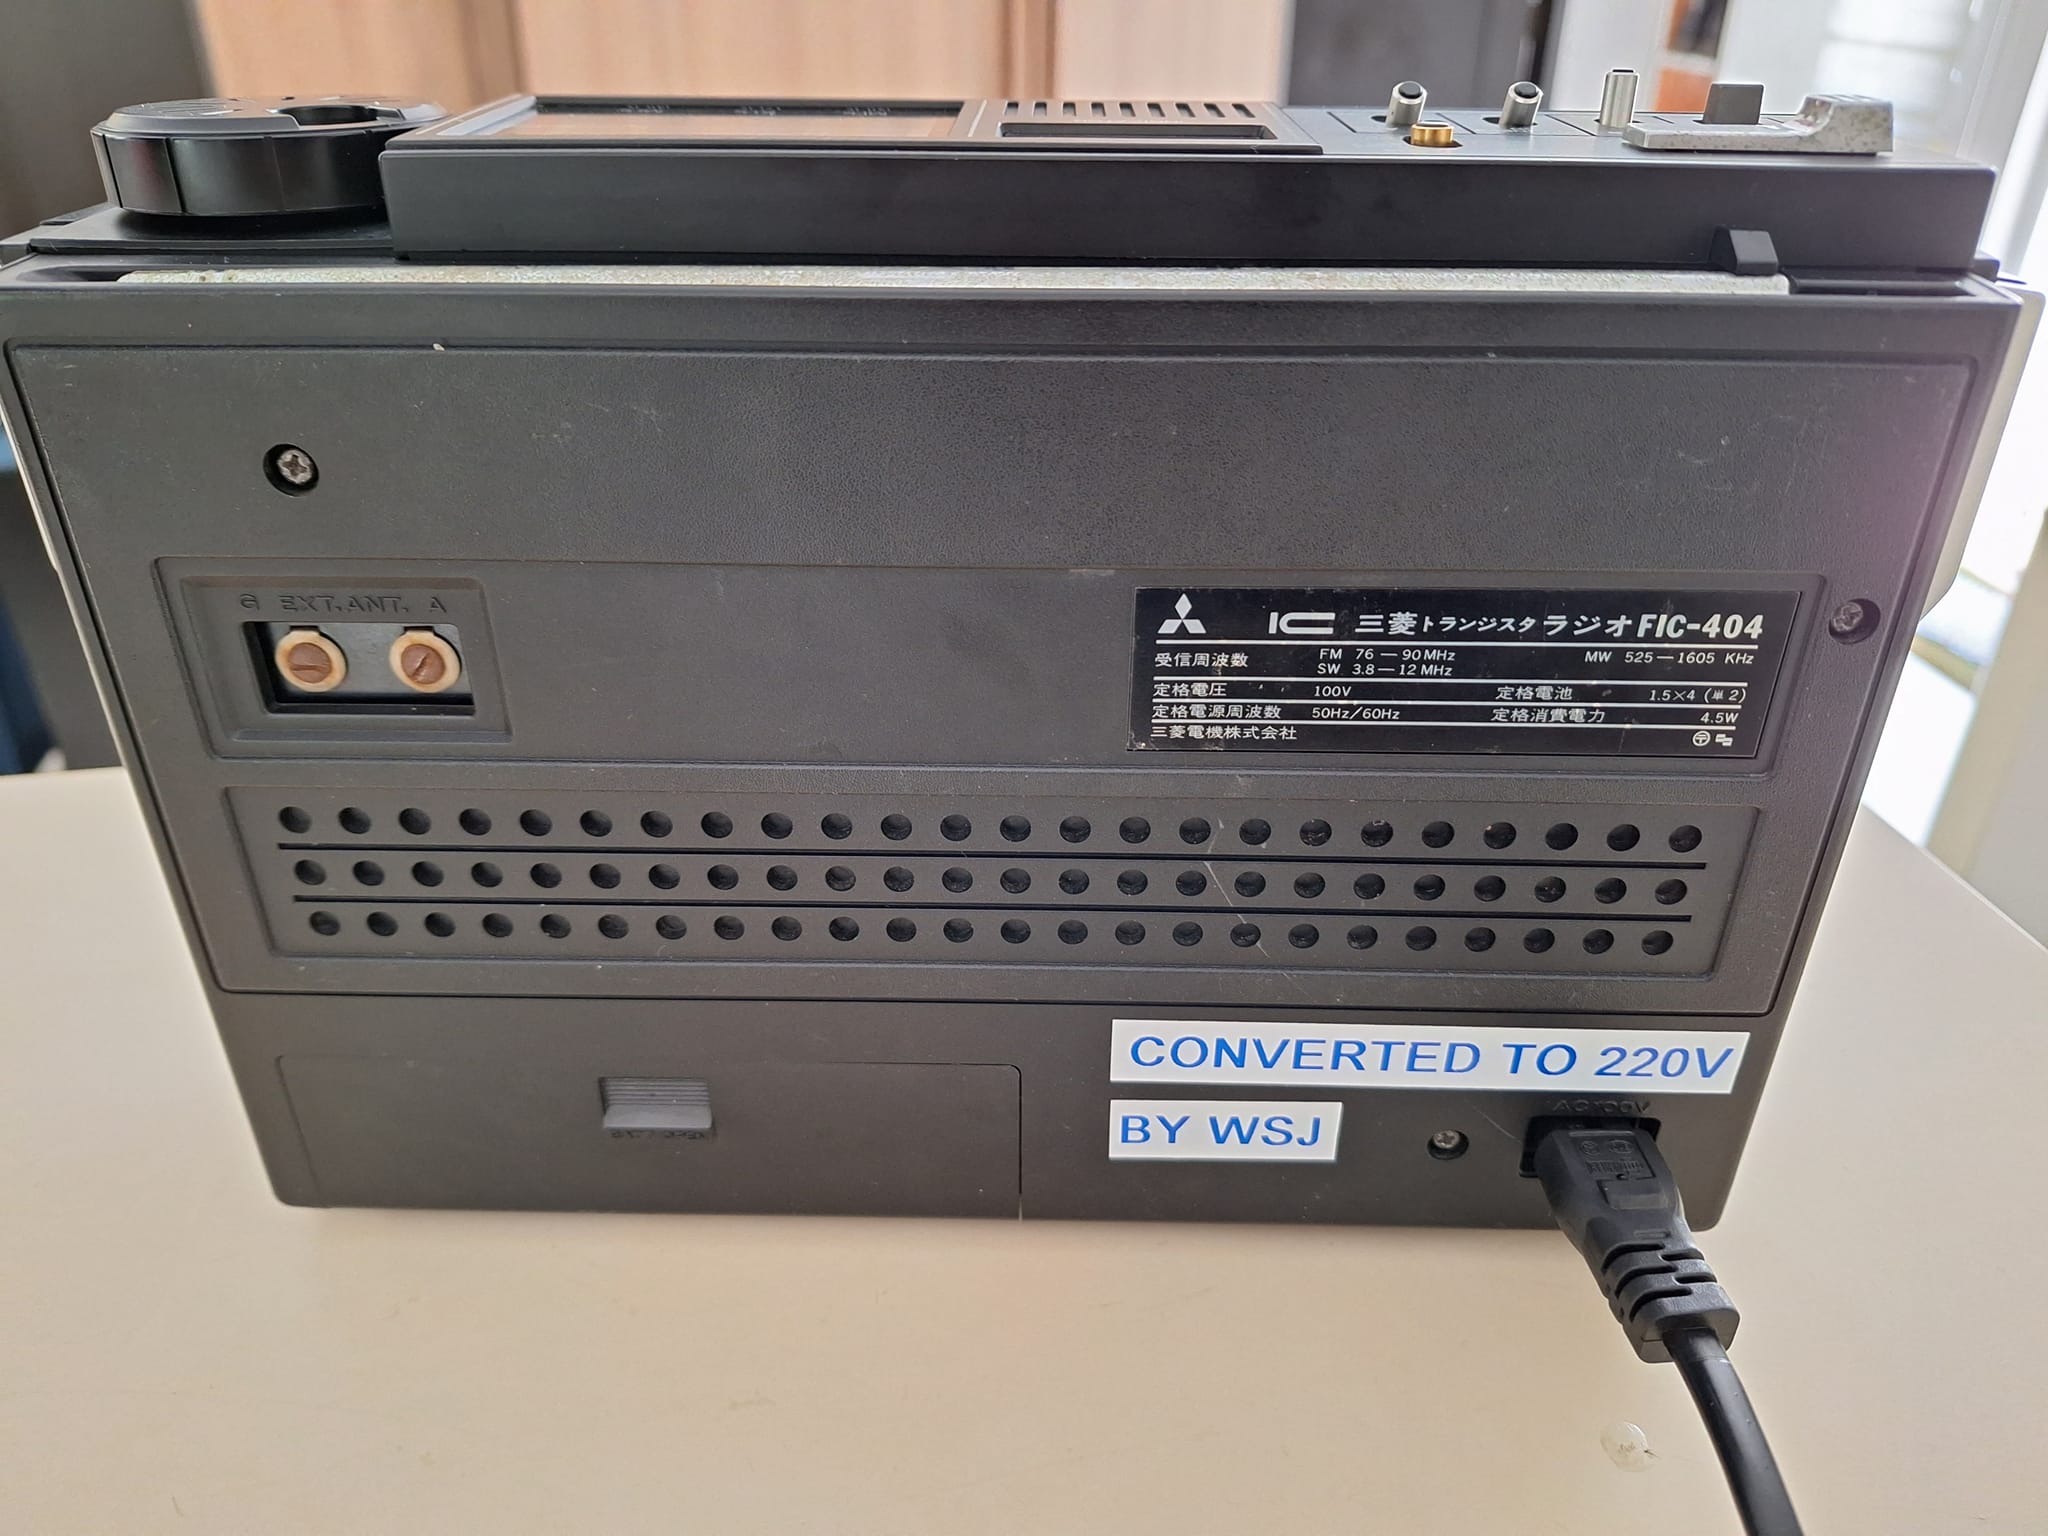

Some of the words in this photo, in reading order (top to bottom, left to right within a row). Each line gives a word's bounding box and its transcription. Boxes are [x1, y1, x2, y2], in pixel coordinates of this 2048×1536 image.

[430, 595, 448, 613] A
[1636, 613, 1764, 640] FIC-404
[1154, 652, 1249, 668] 受信周波数
[1319, 648, 1343, 660] FM
[1584, 651, 1613, 663] MW
[1724, 652, 1755, 665] KHz
[1317, 663, 1341, 675] SW
[1153, 682, 1228, 697] 定格電圧
[1314, 685, 1352, 697] 100V
[1495, 685, 1573, 701] 定格電池
[1152, 704, 1282, 719] 定格電源周波数
[1312, 707, 1400, 720] 50Hz/60Hz
[1491, 708, 1606, 723] 定格消費電力
[1700, 711, 1739, 724] 4.5W
[1150, 725, 1298, 740] 三菱電機株式会社
[1130, 1036, 1482, 1074] CONVERTED
[1503, 1043, 1578, 1077] TO
[1595, 1046, 1734, 1079] 220V
[1120, 1115, 1190, 1145] BY
[1208, 1116, 1322, 1147] WSJ
